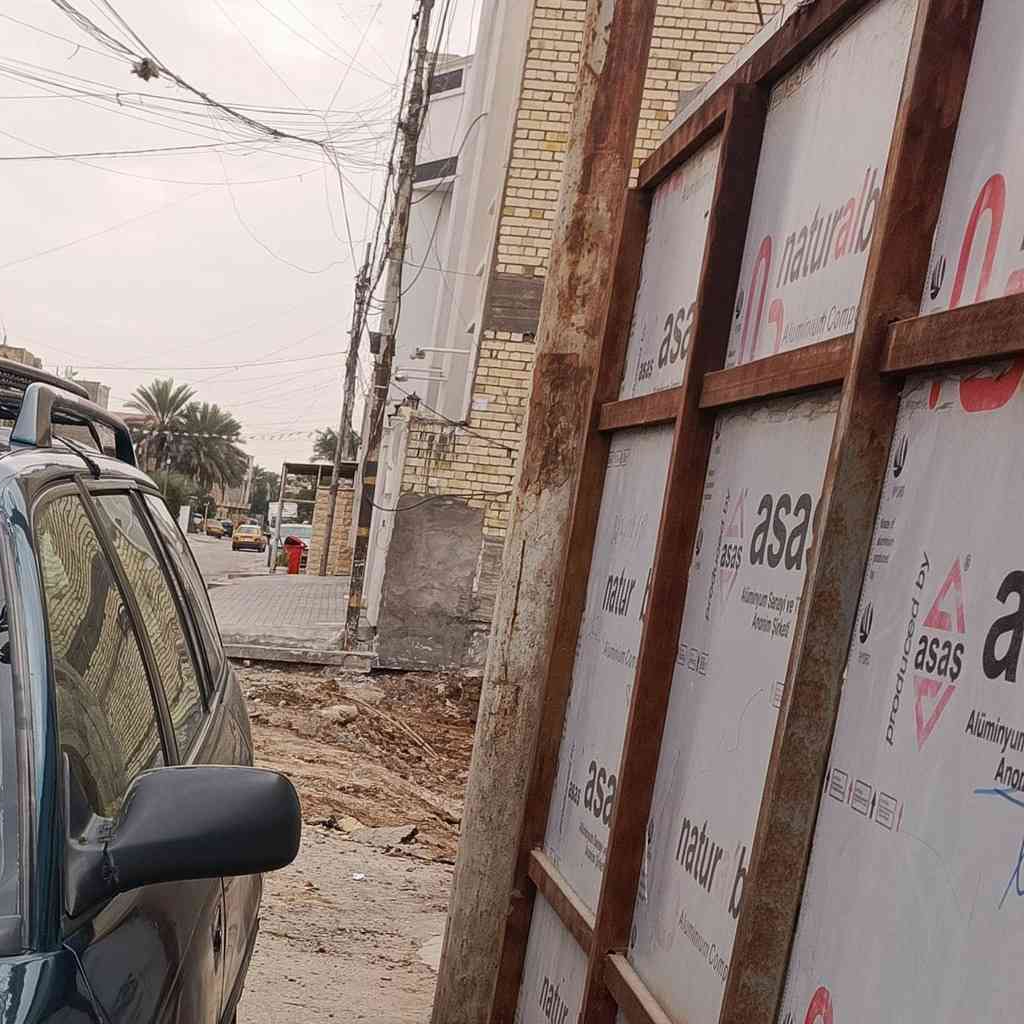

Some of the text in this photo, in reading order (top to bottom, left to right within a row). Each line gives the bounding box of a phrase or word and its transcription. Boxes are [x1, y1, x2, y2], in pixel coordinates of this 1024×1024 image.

[749, 493, 816, 571] asa
[885, 551, 930, 746] produced by
